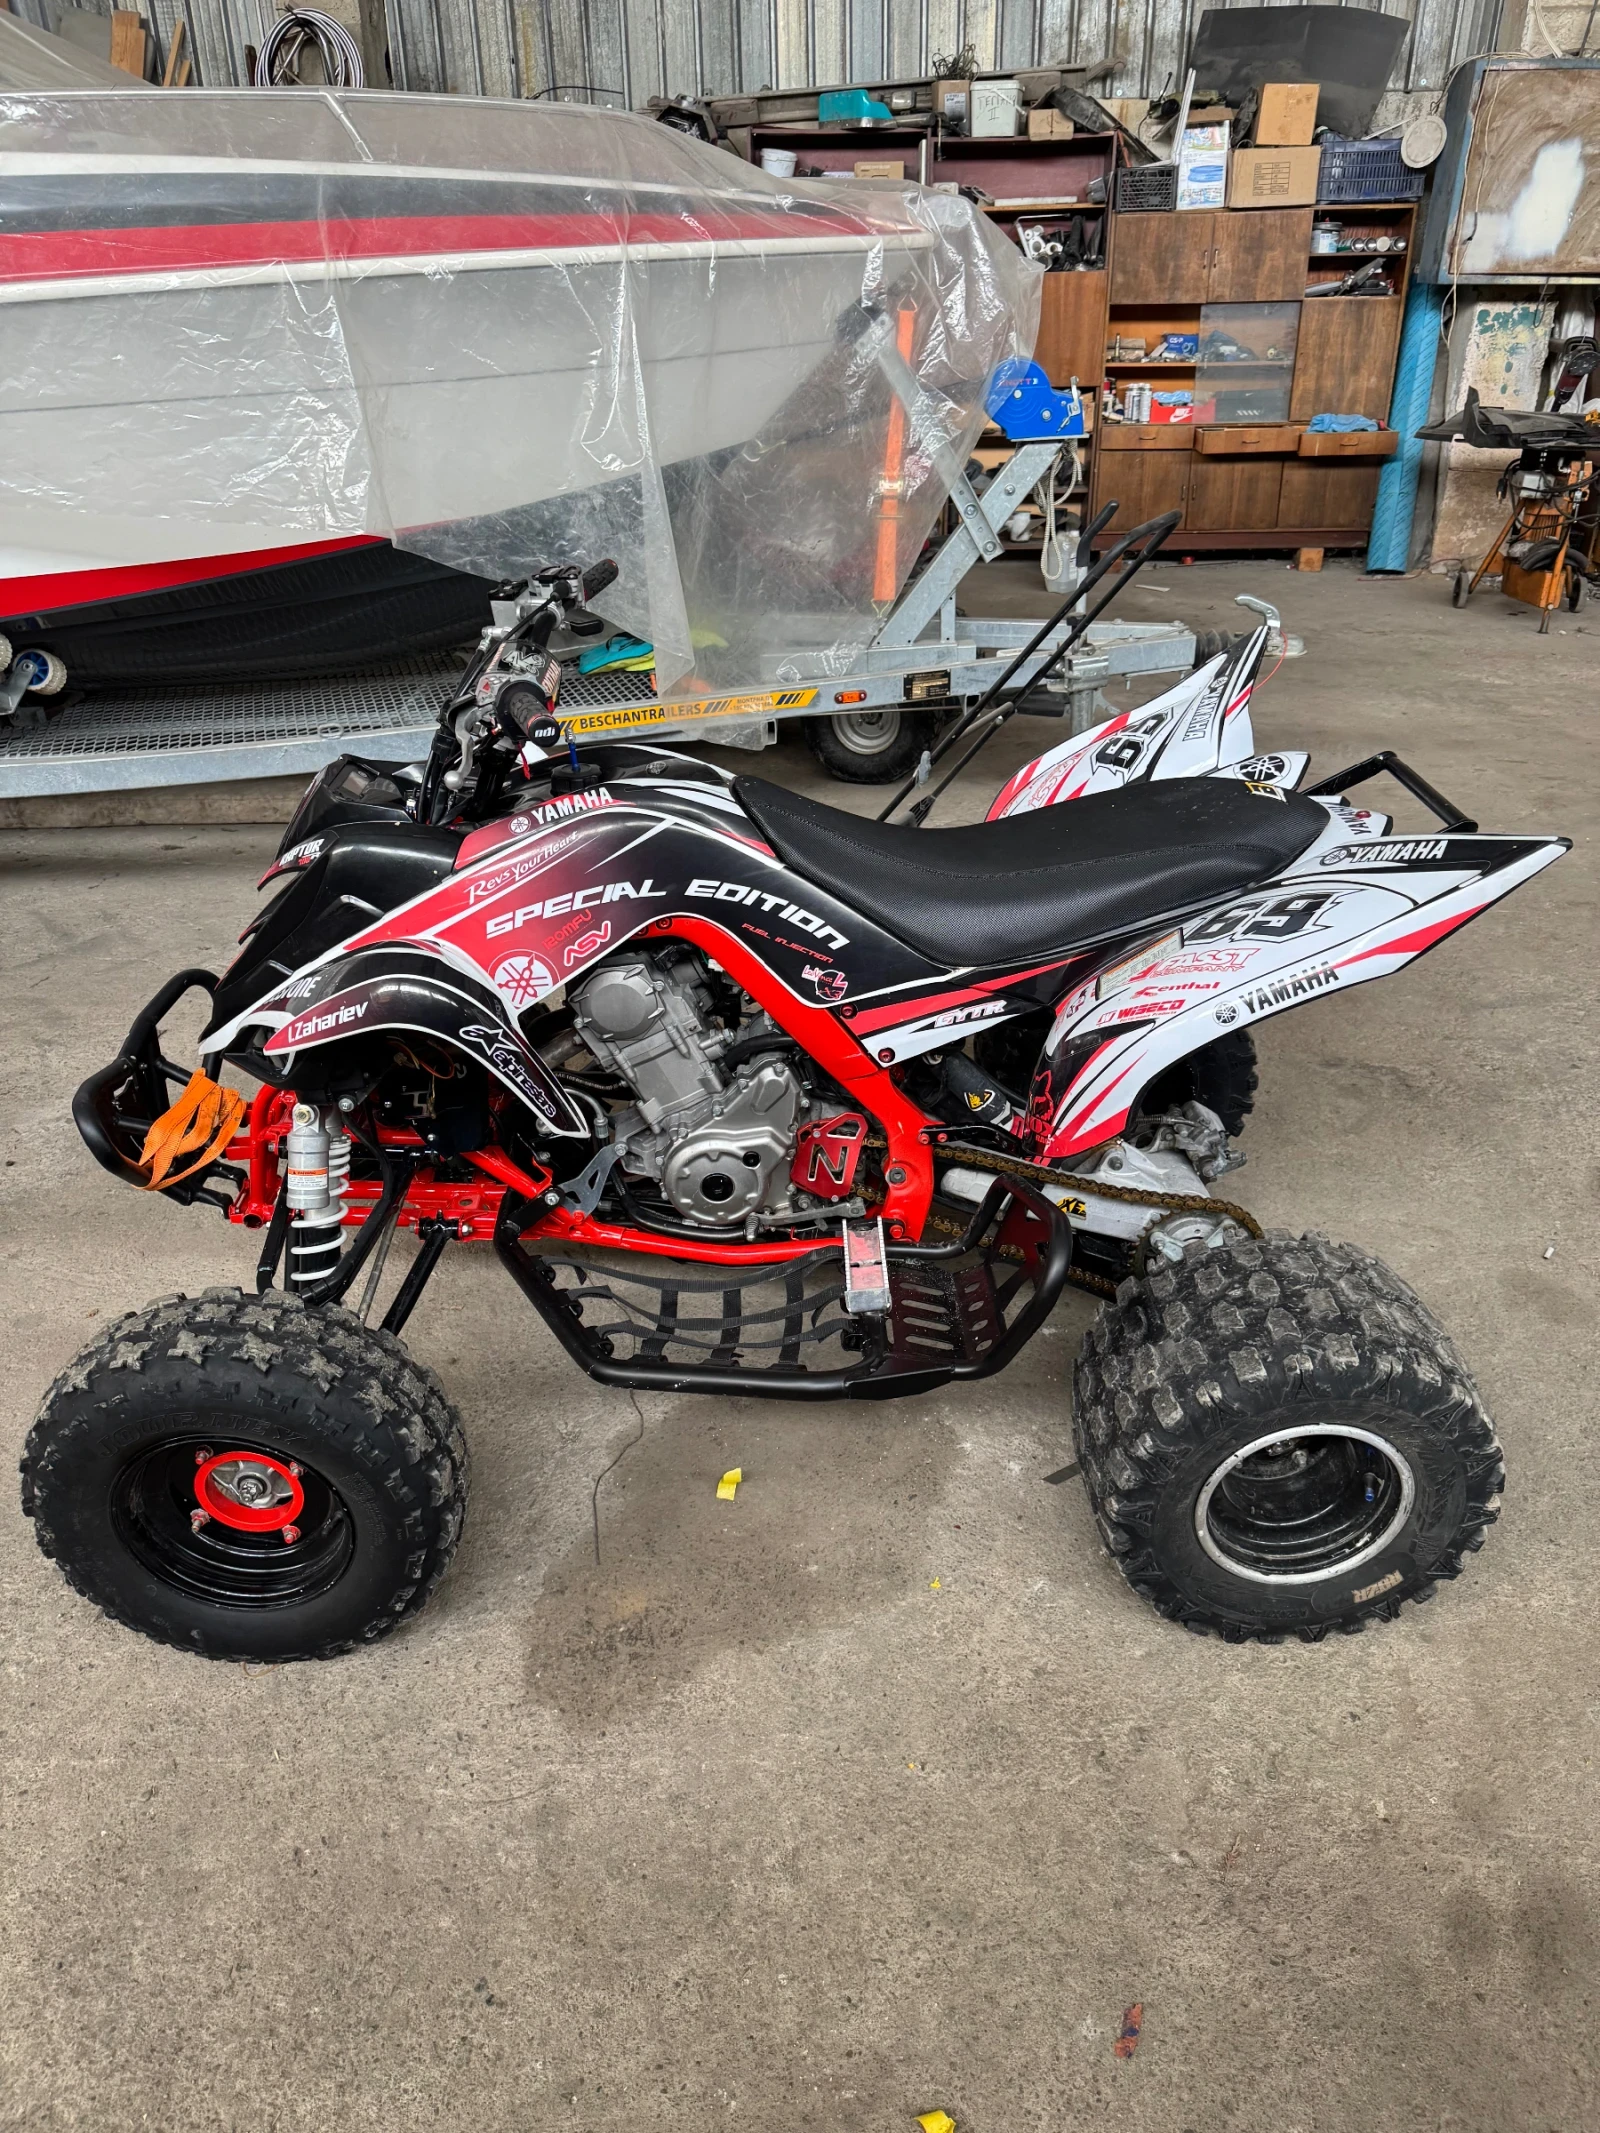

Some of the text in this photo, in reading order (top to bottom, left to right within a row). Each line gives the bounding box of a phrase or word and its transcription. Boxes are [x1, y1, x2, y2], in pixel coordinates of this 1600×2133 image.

[580, 703, 702, 730] BESCHANTRAILERS
[531, 787, 614, 825] YAMAHA
[279, 838, 325, 867] RAPTOR
[464, 830, 578, 905] Revs Your Heart
[1350, 839, 1449, 864] YAMAHA
[486, 879, 667, 940] SPECIAL
[683, 878, 851, 951] EDITION
[1184, 890, 1340, 945] 69
[563, 920, 612, 967] ASV
[741, 922, 834, 964] FUEL INJECTION
[1238, 960, 1340, 1015] YAMAHA
[933, 1000, 1007, 1029] GYTR
[493, 1050, 557, 1118] alpinestars
[1029, 1115, 1055, 1137] OX
